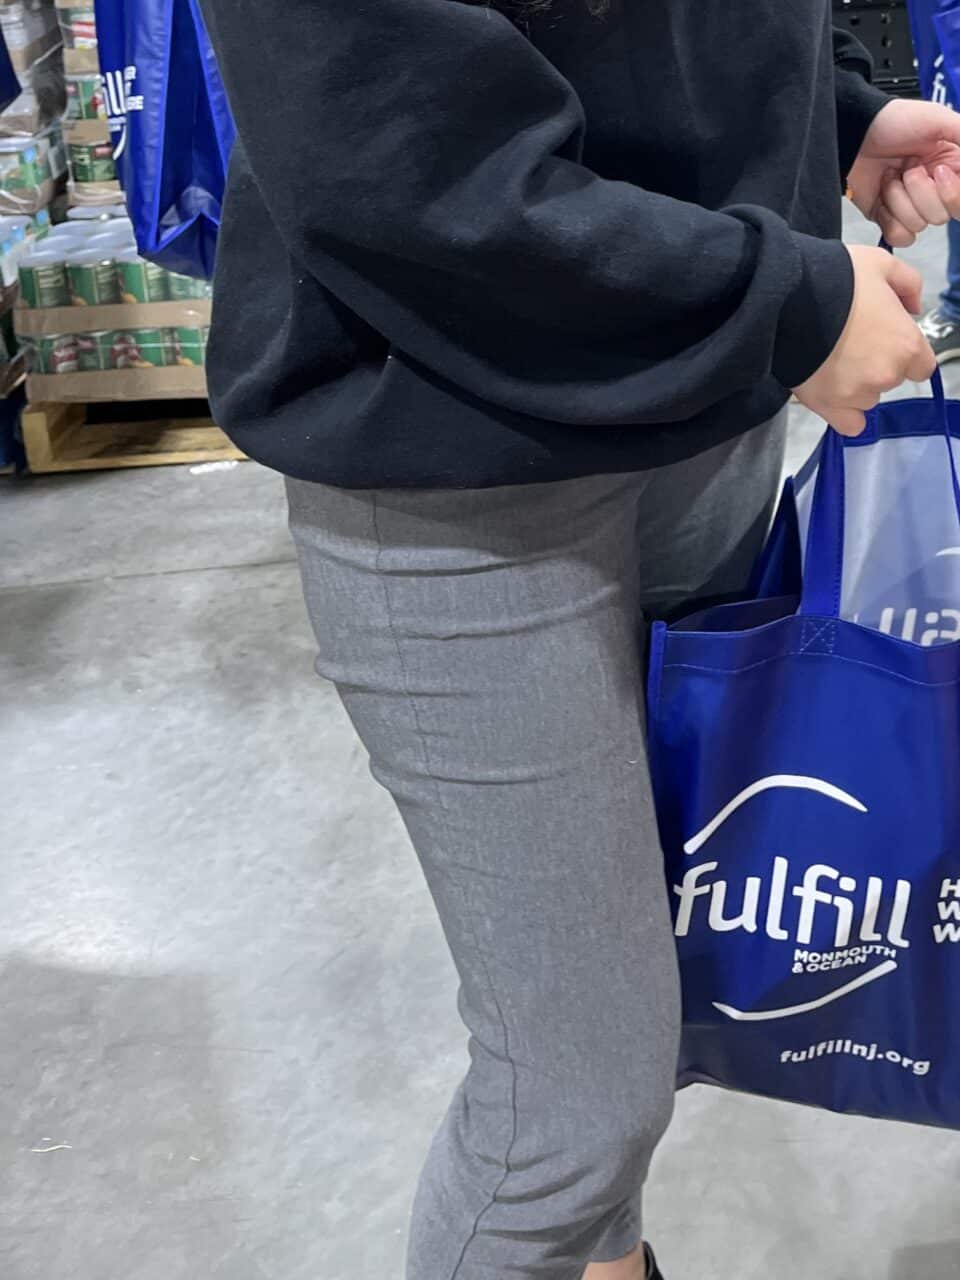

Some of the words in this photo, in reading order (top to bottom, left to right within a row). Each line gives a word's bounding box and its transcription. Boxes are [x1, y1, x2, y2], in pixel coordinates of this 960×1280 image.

[673, 856, 912, 949] fulfill
[793, 944, 898, 963] MONMOUTH
[805, 954, 868, 974] OCEAN
[780, 1039, 931, 1076] fulfillnj.org
